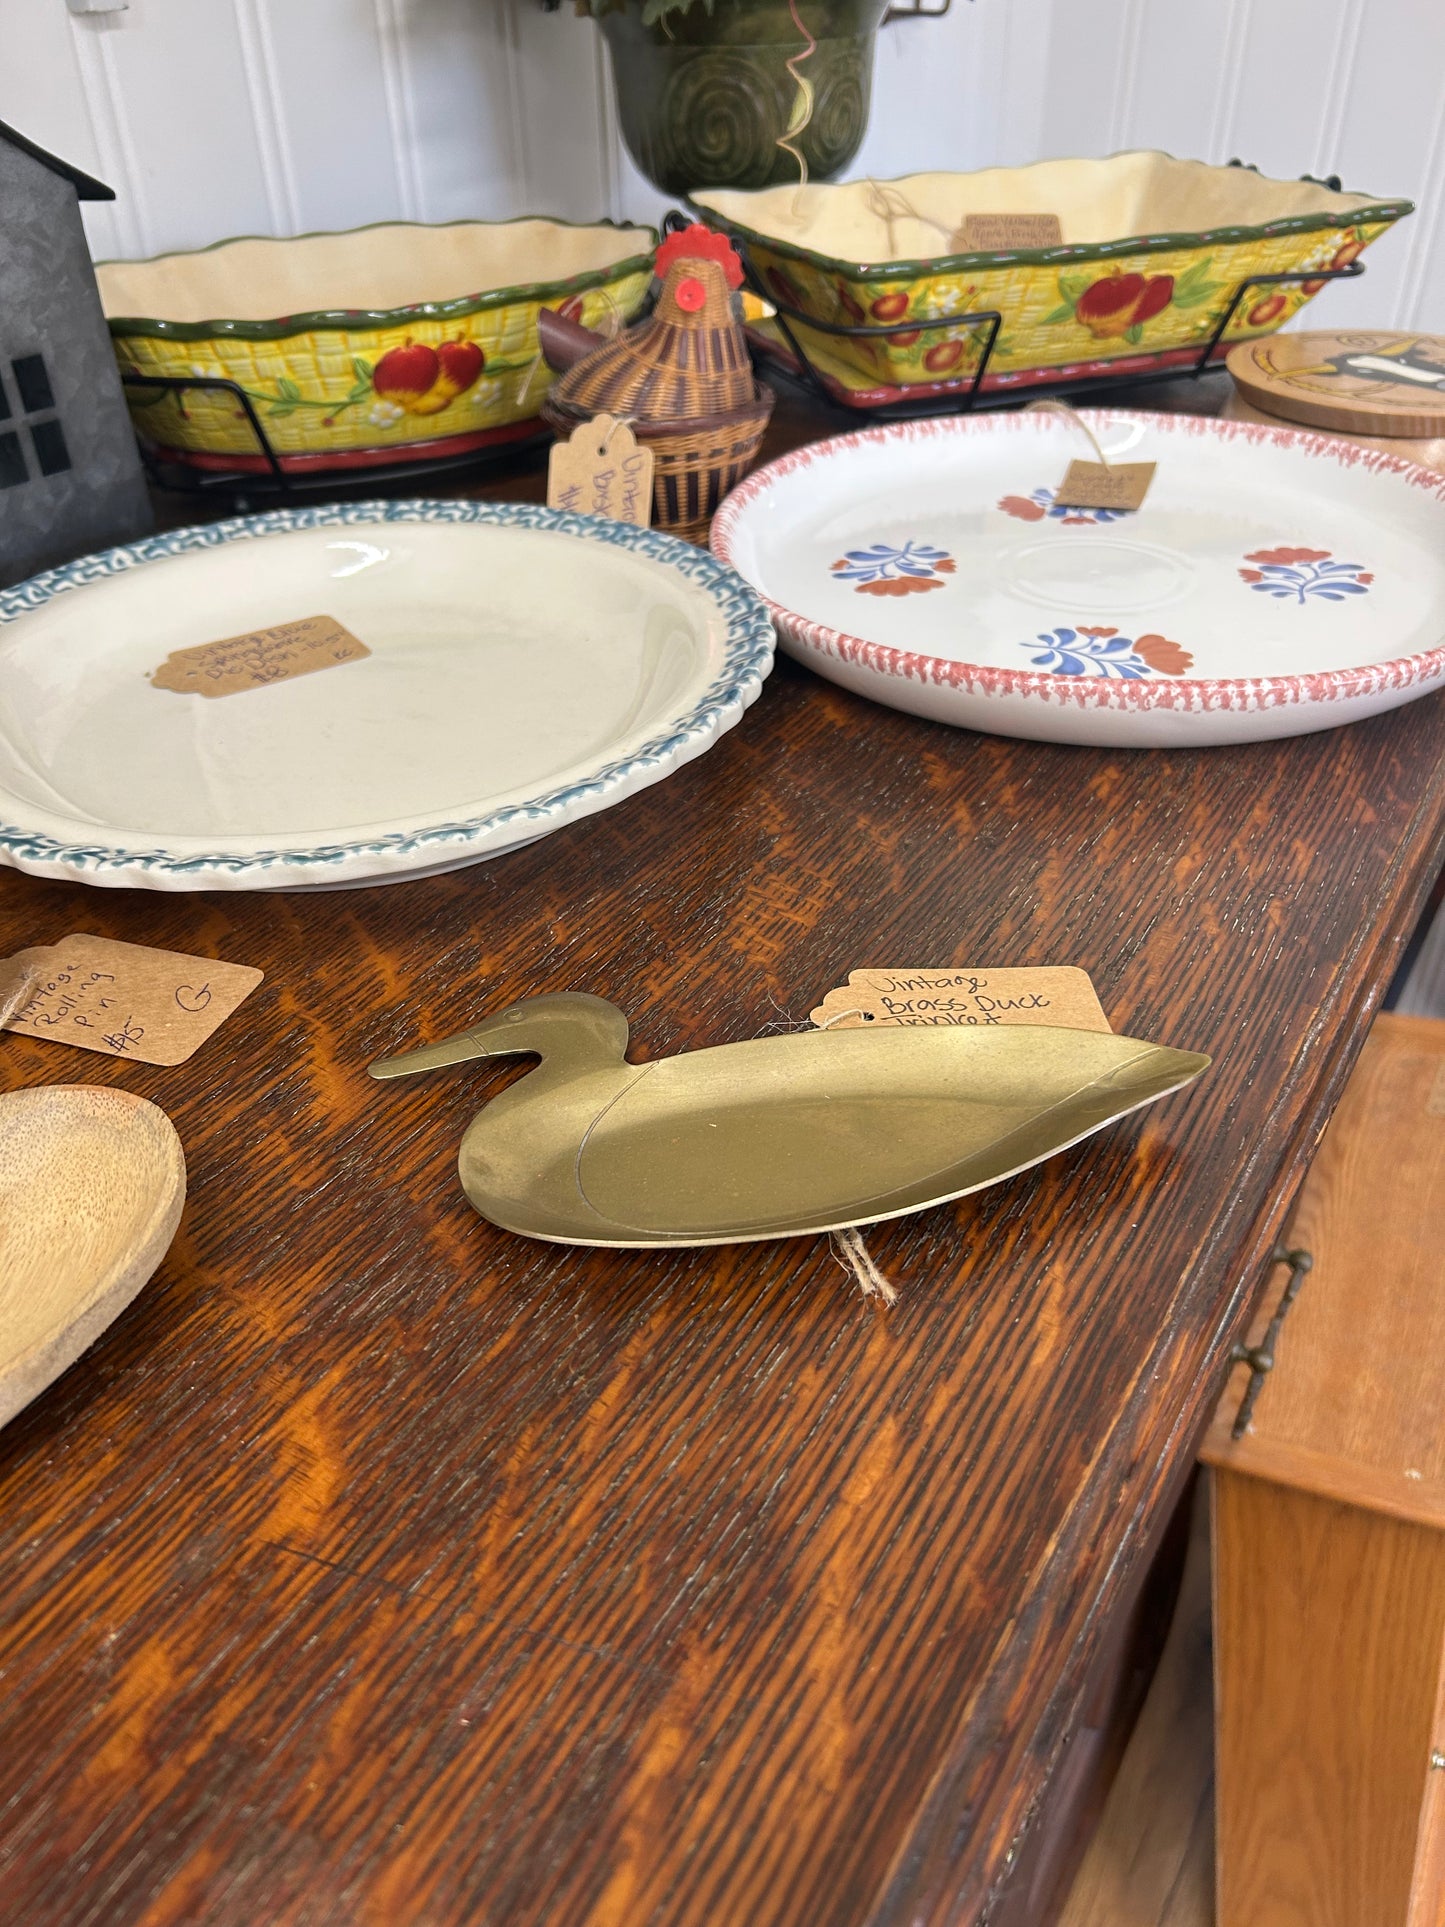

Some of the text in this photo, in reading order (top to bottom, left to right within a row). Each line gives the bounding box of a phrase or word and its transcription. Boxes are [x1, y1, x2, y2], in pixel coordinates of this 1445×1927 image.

[8, 964, 82, 1022] Vintage
[866, 975, 987, 993] Vintage
[33, 972, 115, 1027] Rolling
[74, 998, 118, 1028] Pin
[880, 993, 1051, 1015] Brass Duck
